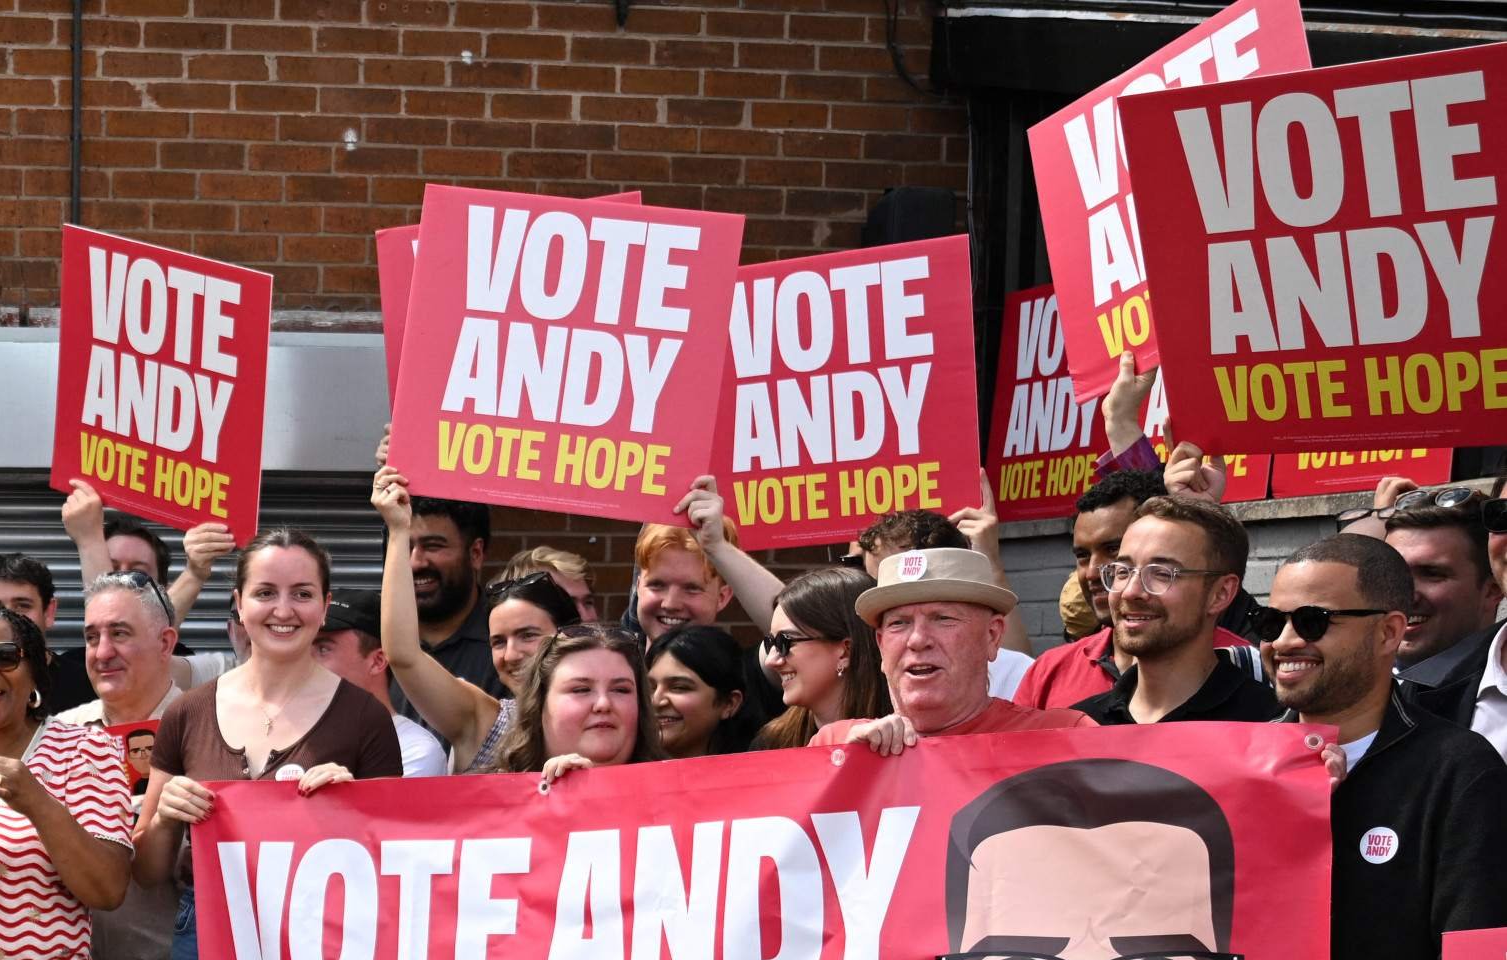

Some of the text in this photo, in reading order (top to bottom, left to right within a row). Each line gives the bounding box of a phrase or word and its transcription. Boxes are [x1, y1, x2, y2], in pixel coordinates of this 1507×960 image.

[1174, 70, 1499, 235] VOTE
[465, 204, 702, 333] VOTE
[1207, 215, 1496, 356] ANDY
[88, 246, 242, 378] VOTE
[729, 255, 934, 379] VOTE
[1016, 294, 1067, 380] VO
[1097, 290, 1150, 359] VO
[82, 344, 234, 464] ANDY
[440, 317, 684, 435] ANDY
[732, 362, 932, 473] ANDY
[1003, 376, 1098, 458] ANDY
[1213, 353, 1352, 423] VOTE
[1365, 346, 1507, 419] HOPE
[79, 431, 145, 494] VOTE
[153, 454, 230, 519] HOPE
[437, 420, 671, 496] VOTE HOPE
[733, 462, 942, 526] VOTE HOPE
[999, 453, 1098, 501] VOTE HOPE
[902, 567, 921, 576] ANDY
[905, 557, 922, 566] VOTE
[1366, 846, 1391, 857] ANDY
[1368, 834, 1393, 846] VOTE
